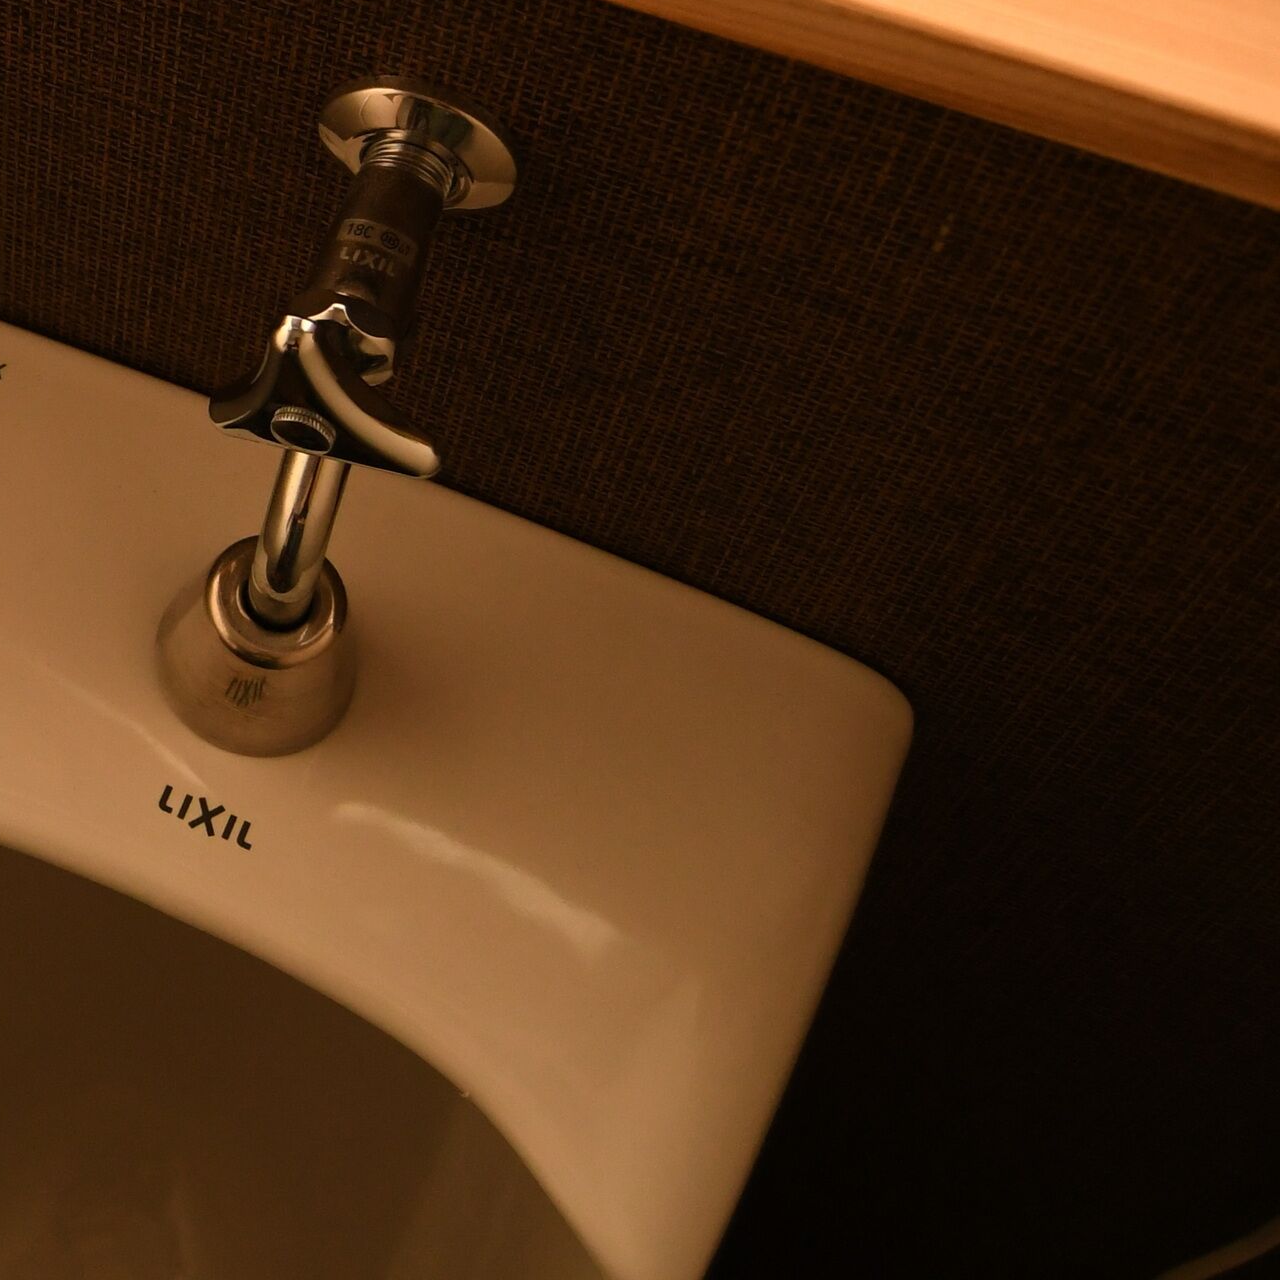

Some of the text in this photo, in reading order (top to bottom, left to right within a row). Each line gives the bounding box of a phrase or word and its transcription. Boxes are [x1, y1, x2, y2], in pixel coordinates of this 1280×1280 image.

[347, 223, 374, 238] 18C
[339, 246, 395, 277] LIXIL
[159, 785, 252, 850] LIXIL
